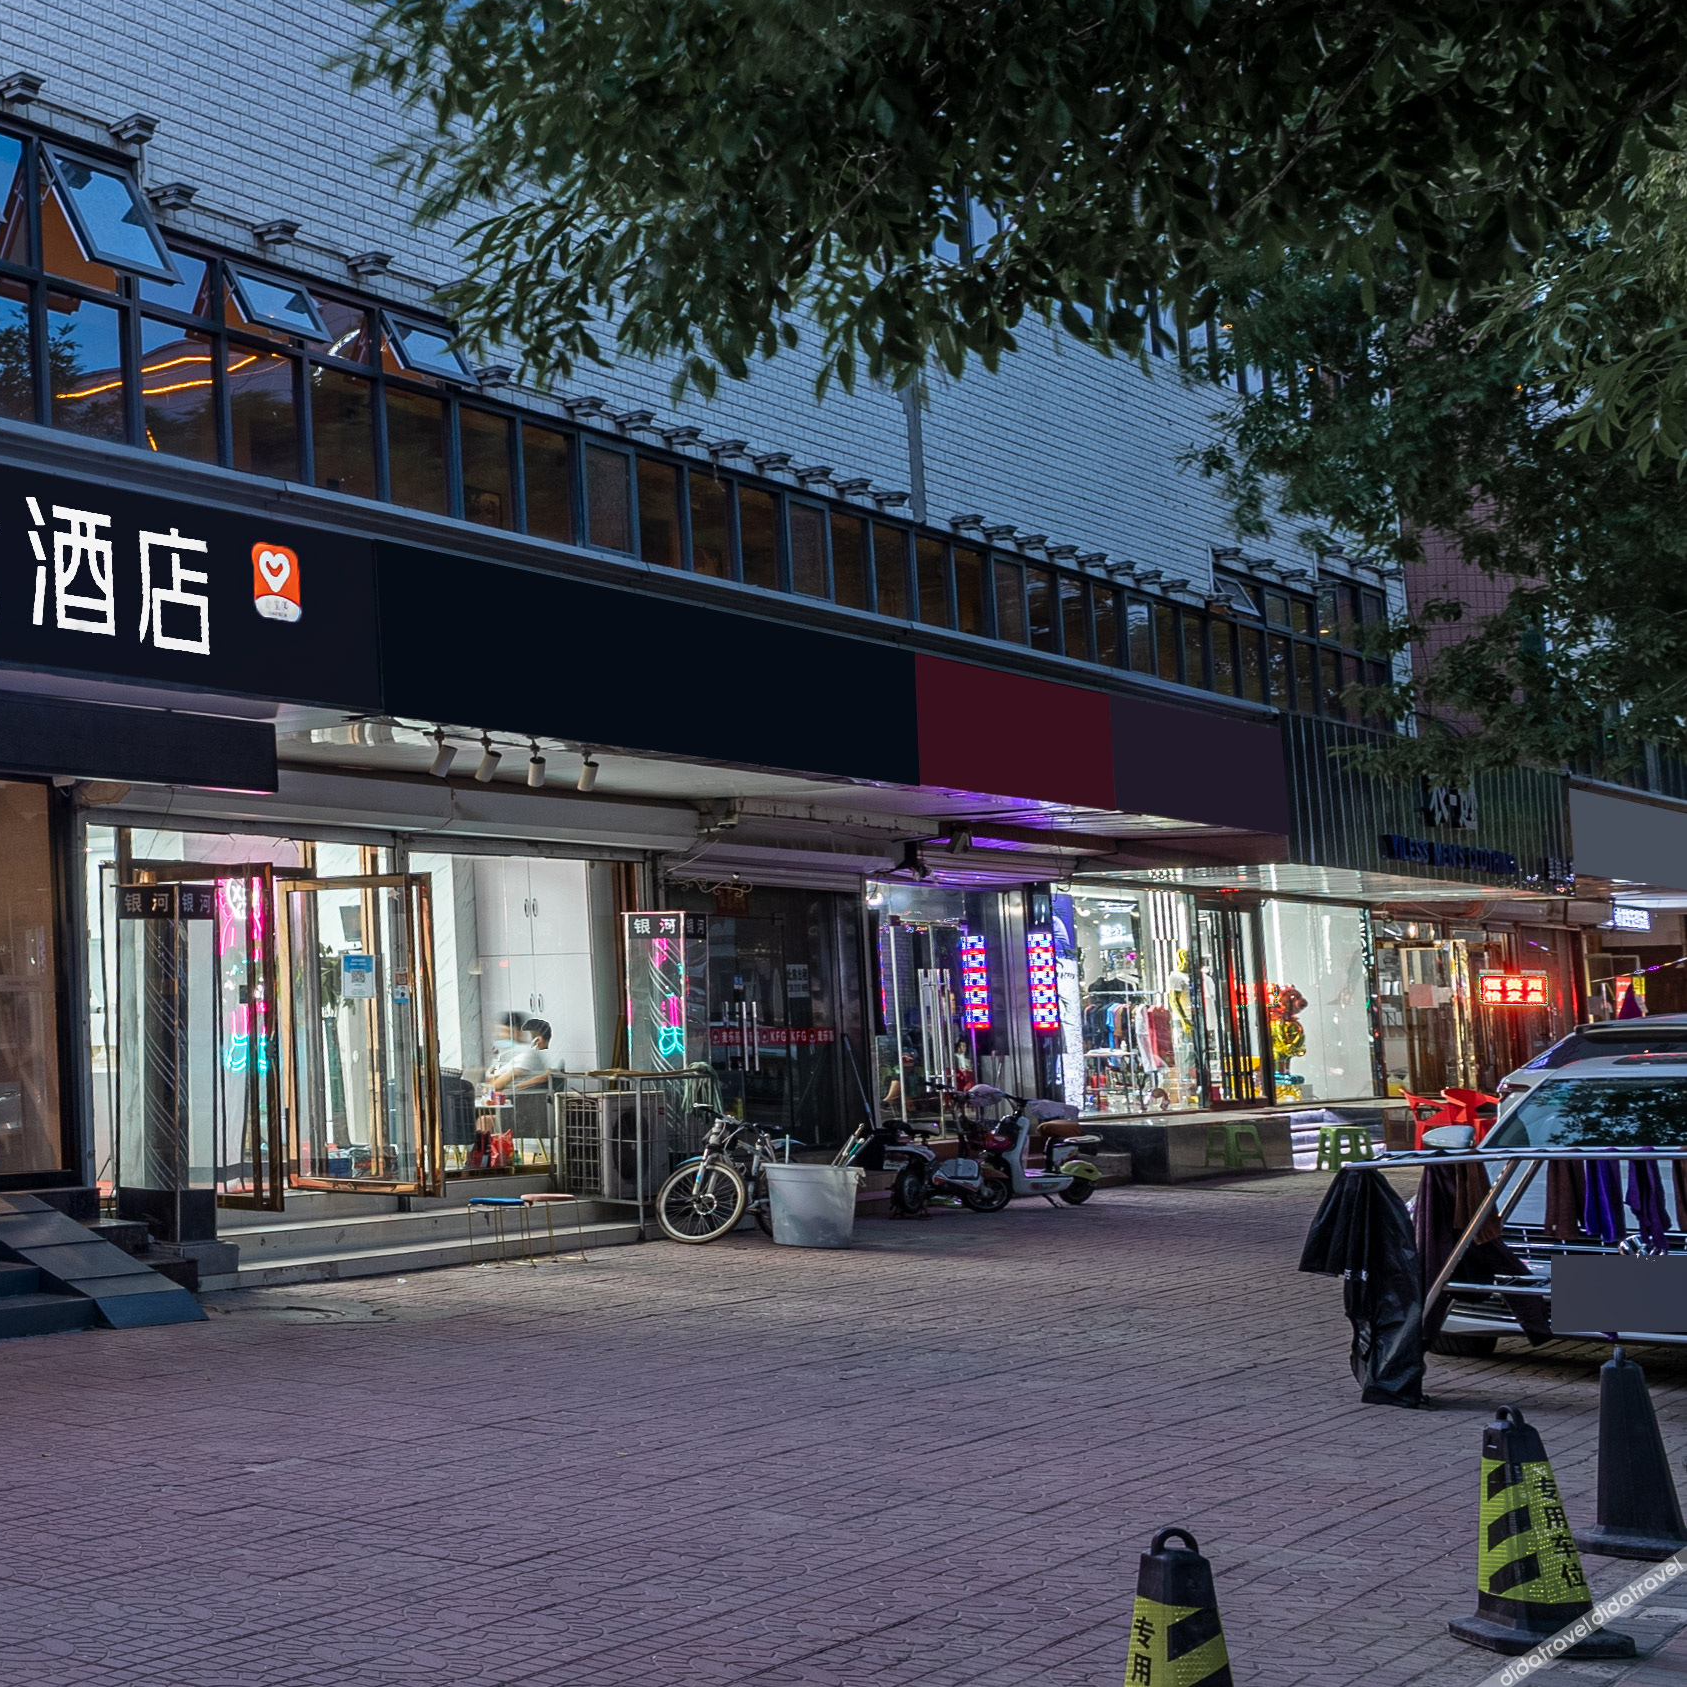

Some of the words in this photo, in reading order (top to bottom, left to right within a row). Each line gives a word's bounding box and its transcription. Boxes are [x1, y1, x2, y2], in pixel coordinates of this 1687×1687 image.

[125, 892, 170, 912] 银河
[181, 892, 211, 914] 银河
[633, 918, 677, 934] 银河
[1534, 1476, 1587, 1588] 专用车位
[1131, 1616, 1155, 1686] 专用
